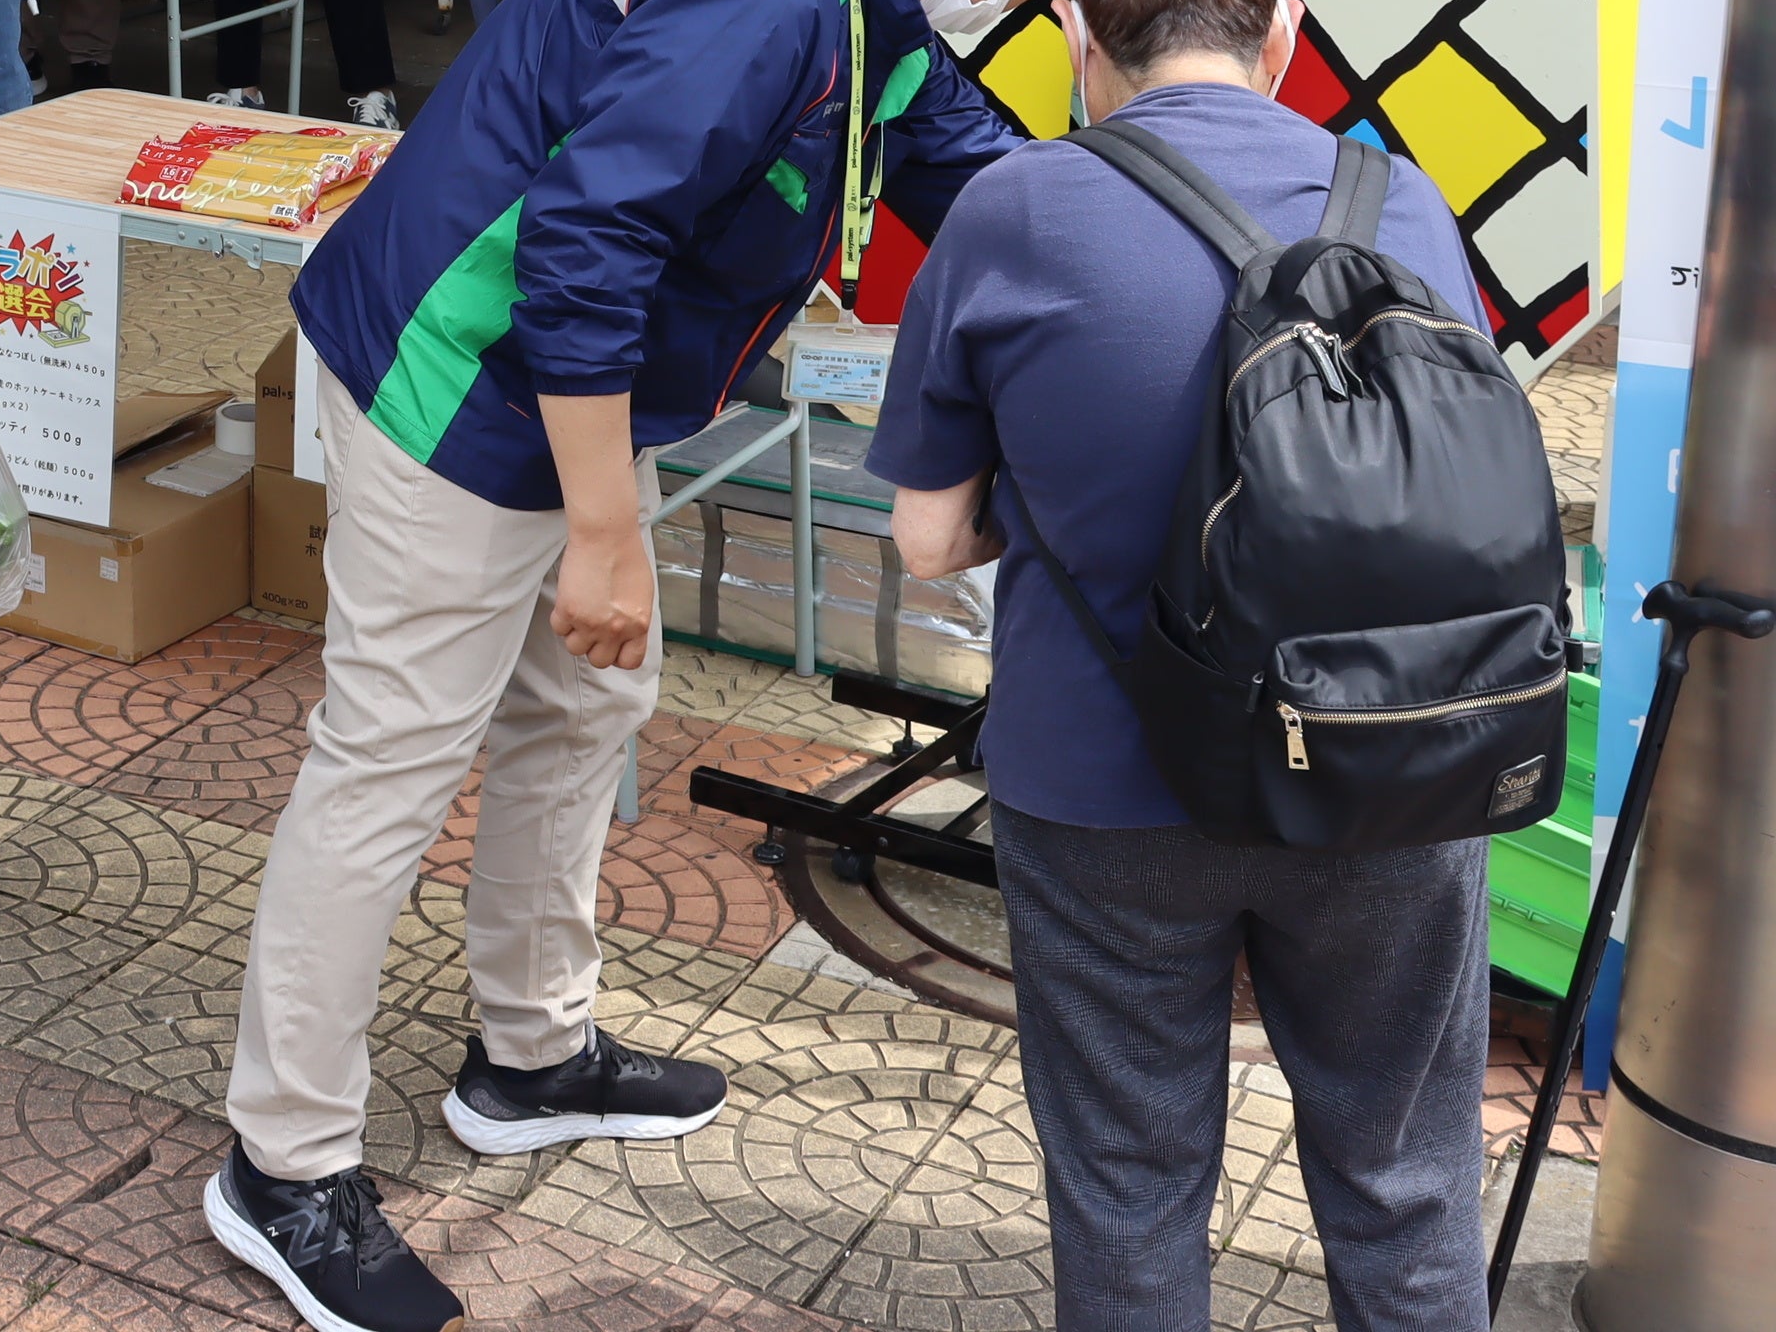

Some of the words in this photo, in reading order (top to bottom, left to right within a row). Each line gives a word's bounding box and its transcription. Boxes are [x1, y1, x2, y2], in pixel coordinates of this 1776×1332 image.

[141, 148, 204, 166] スパゲッティ
[164, 167, 176, 176] 1.6
[42, 428, 82, 447] 500g
[18, 484, 84, 506] 限りがあります。
[309, 525, 326, 541] 試
